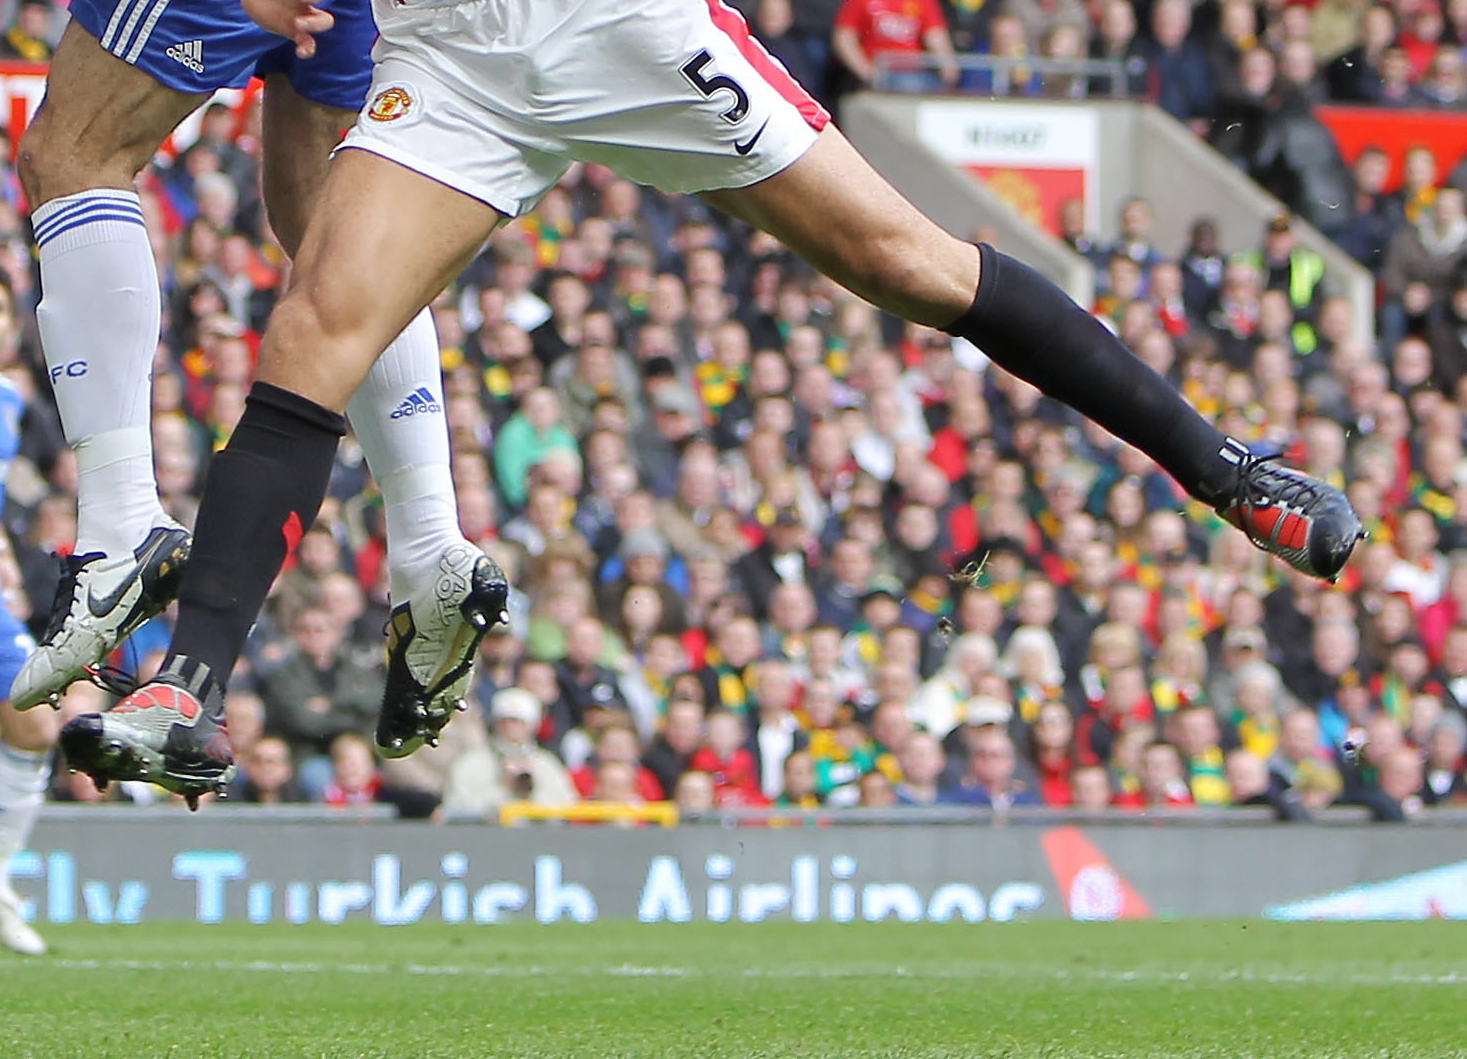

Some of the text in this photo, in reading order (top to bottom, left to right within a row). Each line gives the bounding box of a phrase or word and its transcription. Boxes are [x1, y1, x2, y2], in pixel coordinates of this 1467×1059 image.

[165, 46, 205, 74] adidas
[678, 48, 750, 126] 5
[50, 360, 88, 385] FC
[171, 850, 598, 925] Turkish
[637, 854, 1044, 923] Airlines
